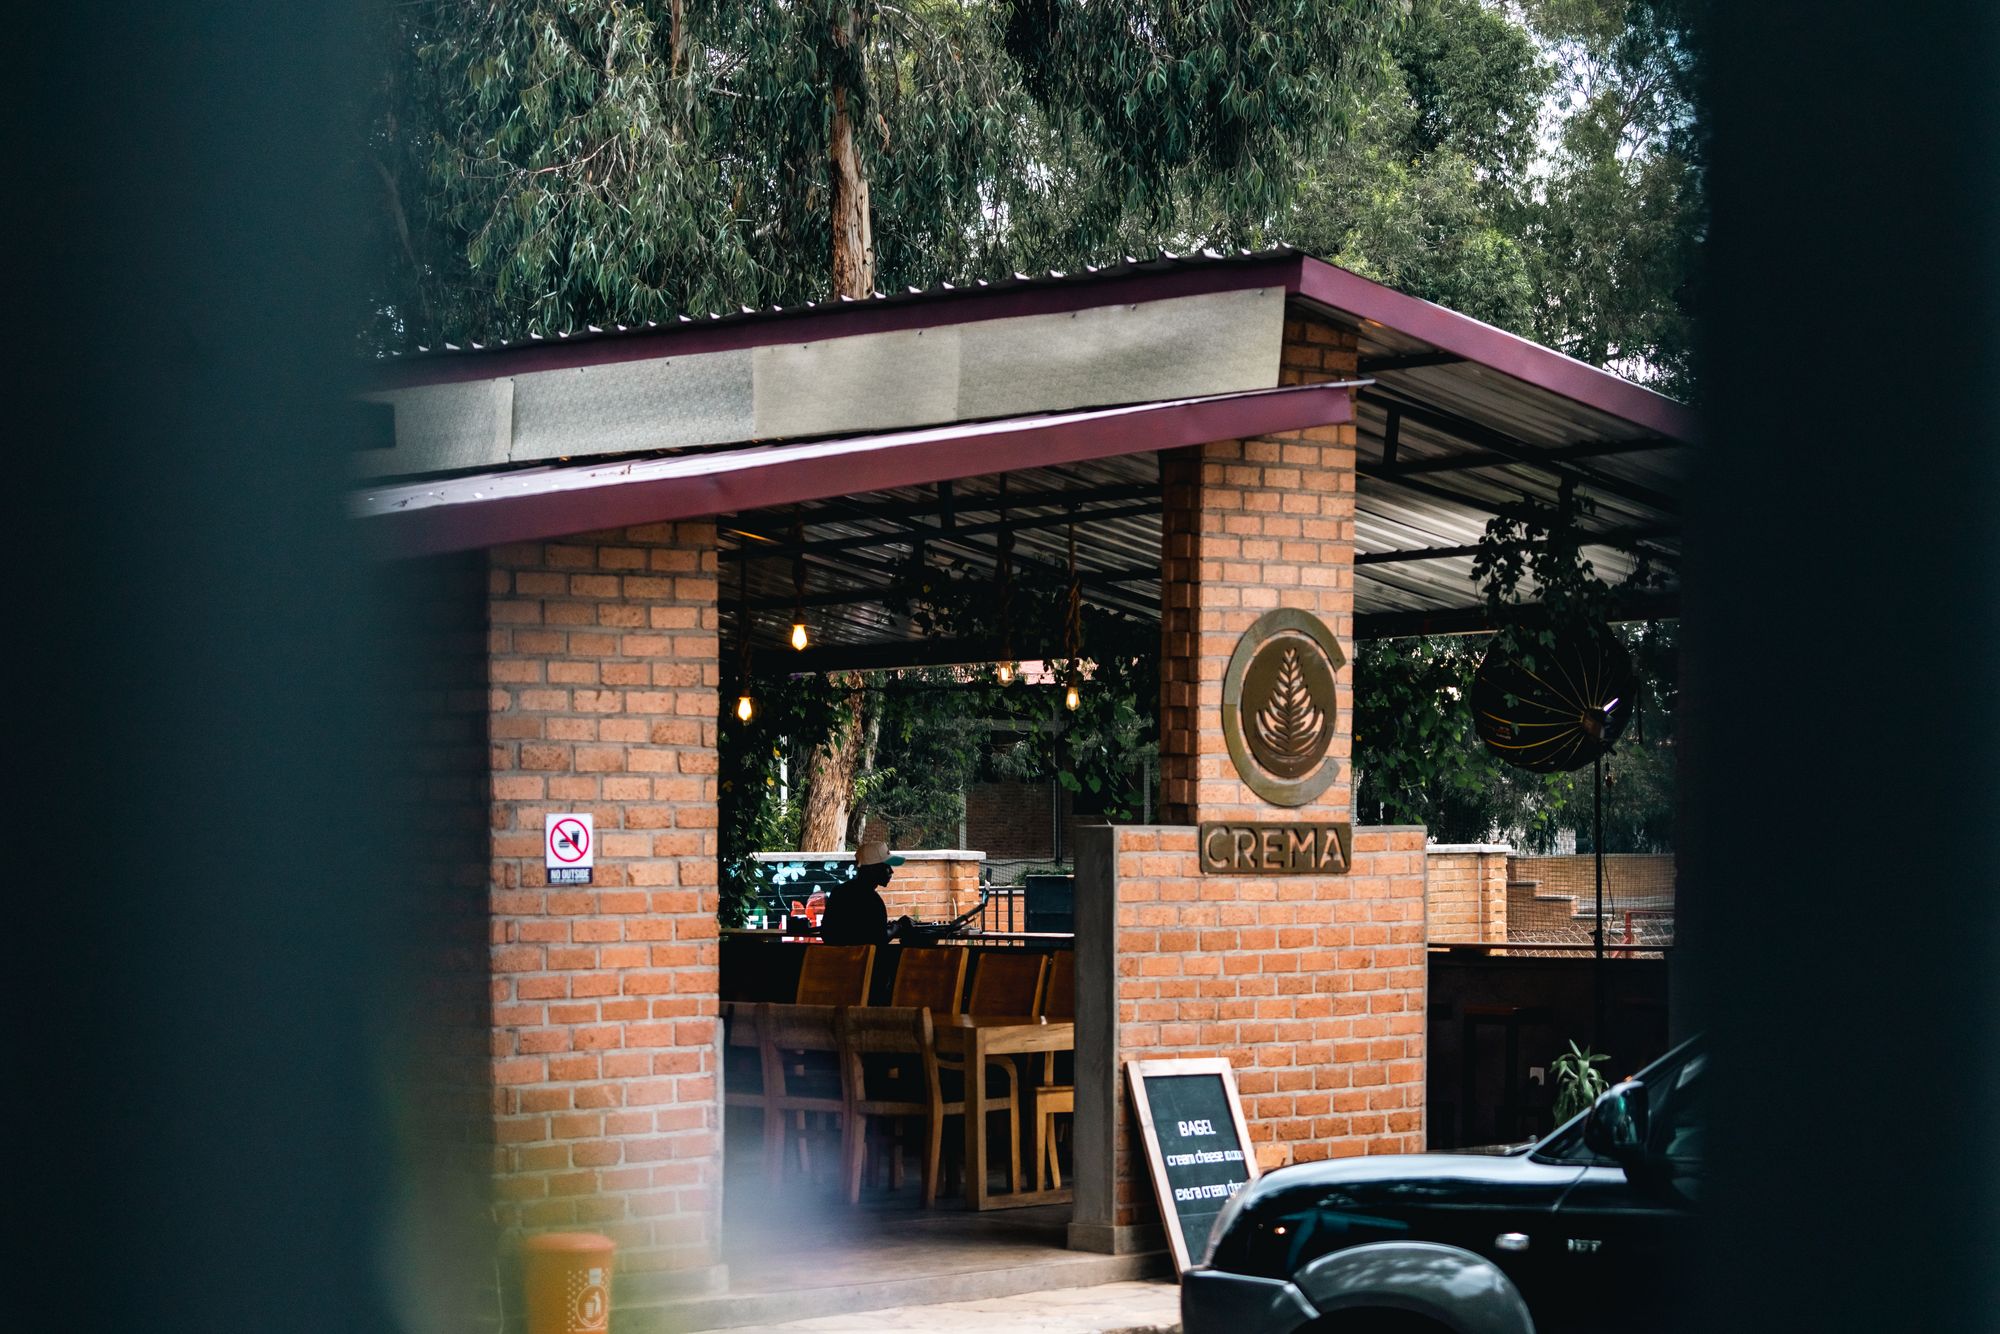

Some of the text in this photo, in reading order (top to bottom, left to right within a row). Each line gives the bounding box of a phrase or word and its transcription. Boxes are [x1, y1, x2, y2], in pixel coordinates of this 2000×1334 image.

[1204, 826, 1346, 869] CREMA
[550, 868, 590, 879] NO OUTSIDE
[1178, 1119, 1217, 1137] BAGEL
[1166, 1153, 1196, 1167] cream
[1195, 1149, 1225, 1164] cheese
[1174, 1186, 1203, 1201] extra
[1201, 1183, 1228, 1198] cream
